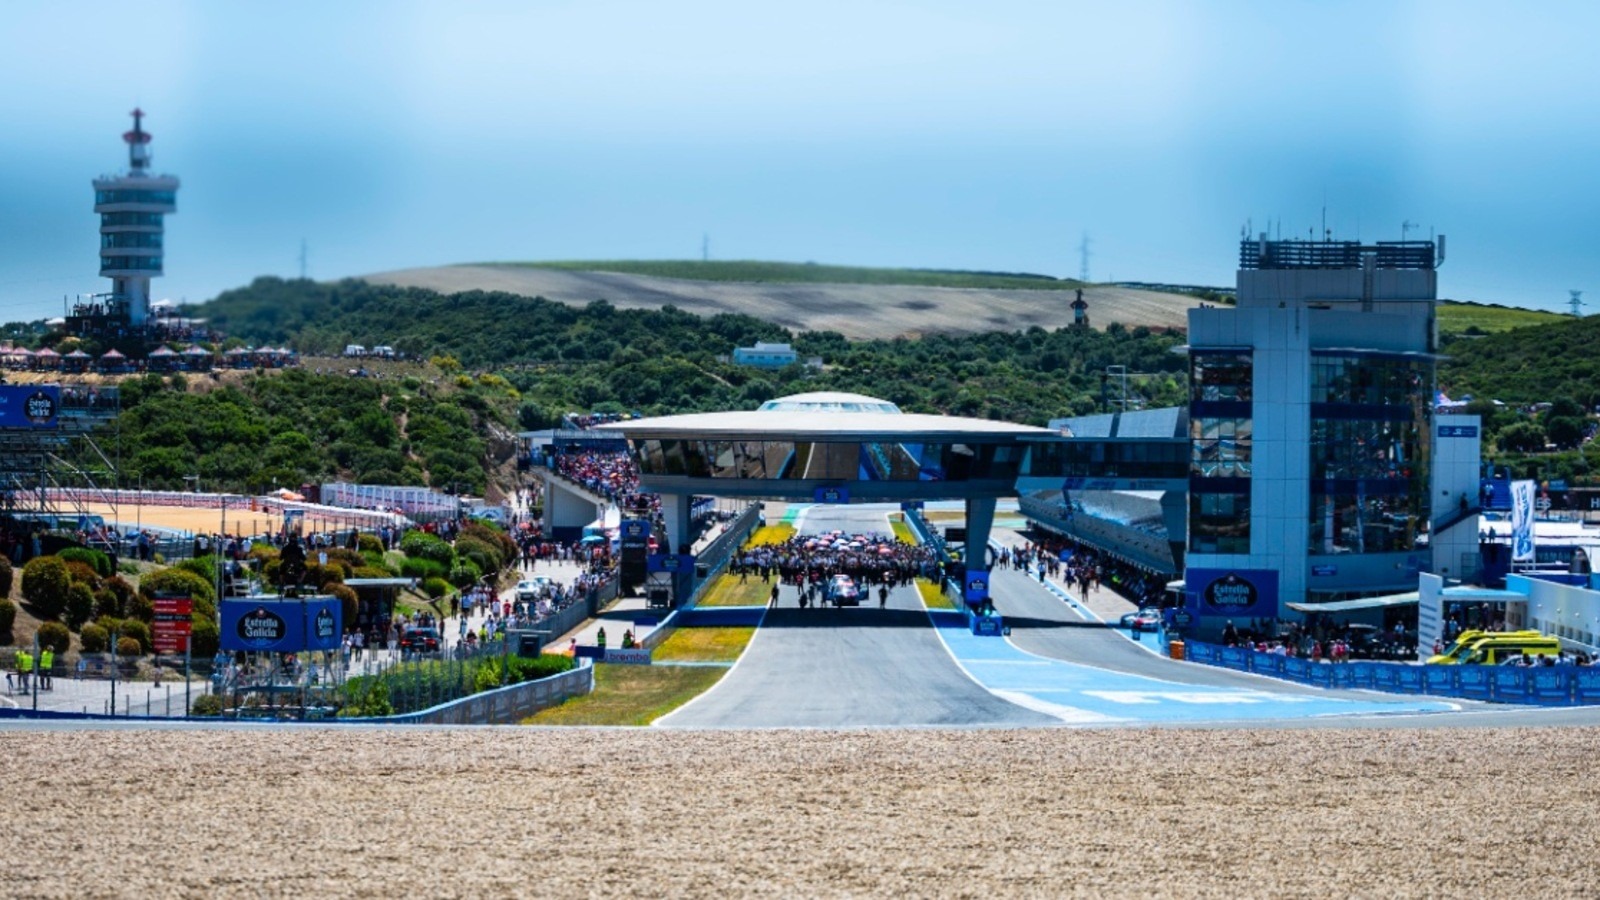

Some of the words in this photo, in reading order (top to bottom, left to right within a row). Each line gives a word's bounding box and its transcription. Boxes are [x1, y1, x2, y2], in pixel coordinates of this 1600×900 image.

[1213, 584, 1249, 595] Estrella
[1214, 594, 1248, 604] Galicia
[244, 616, 278, 628] Estrella
[245, 626, 277, 637] Galicia
